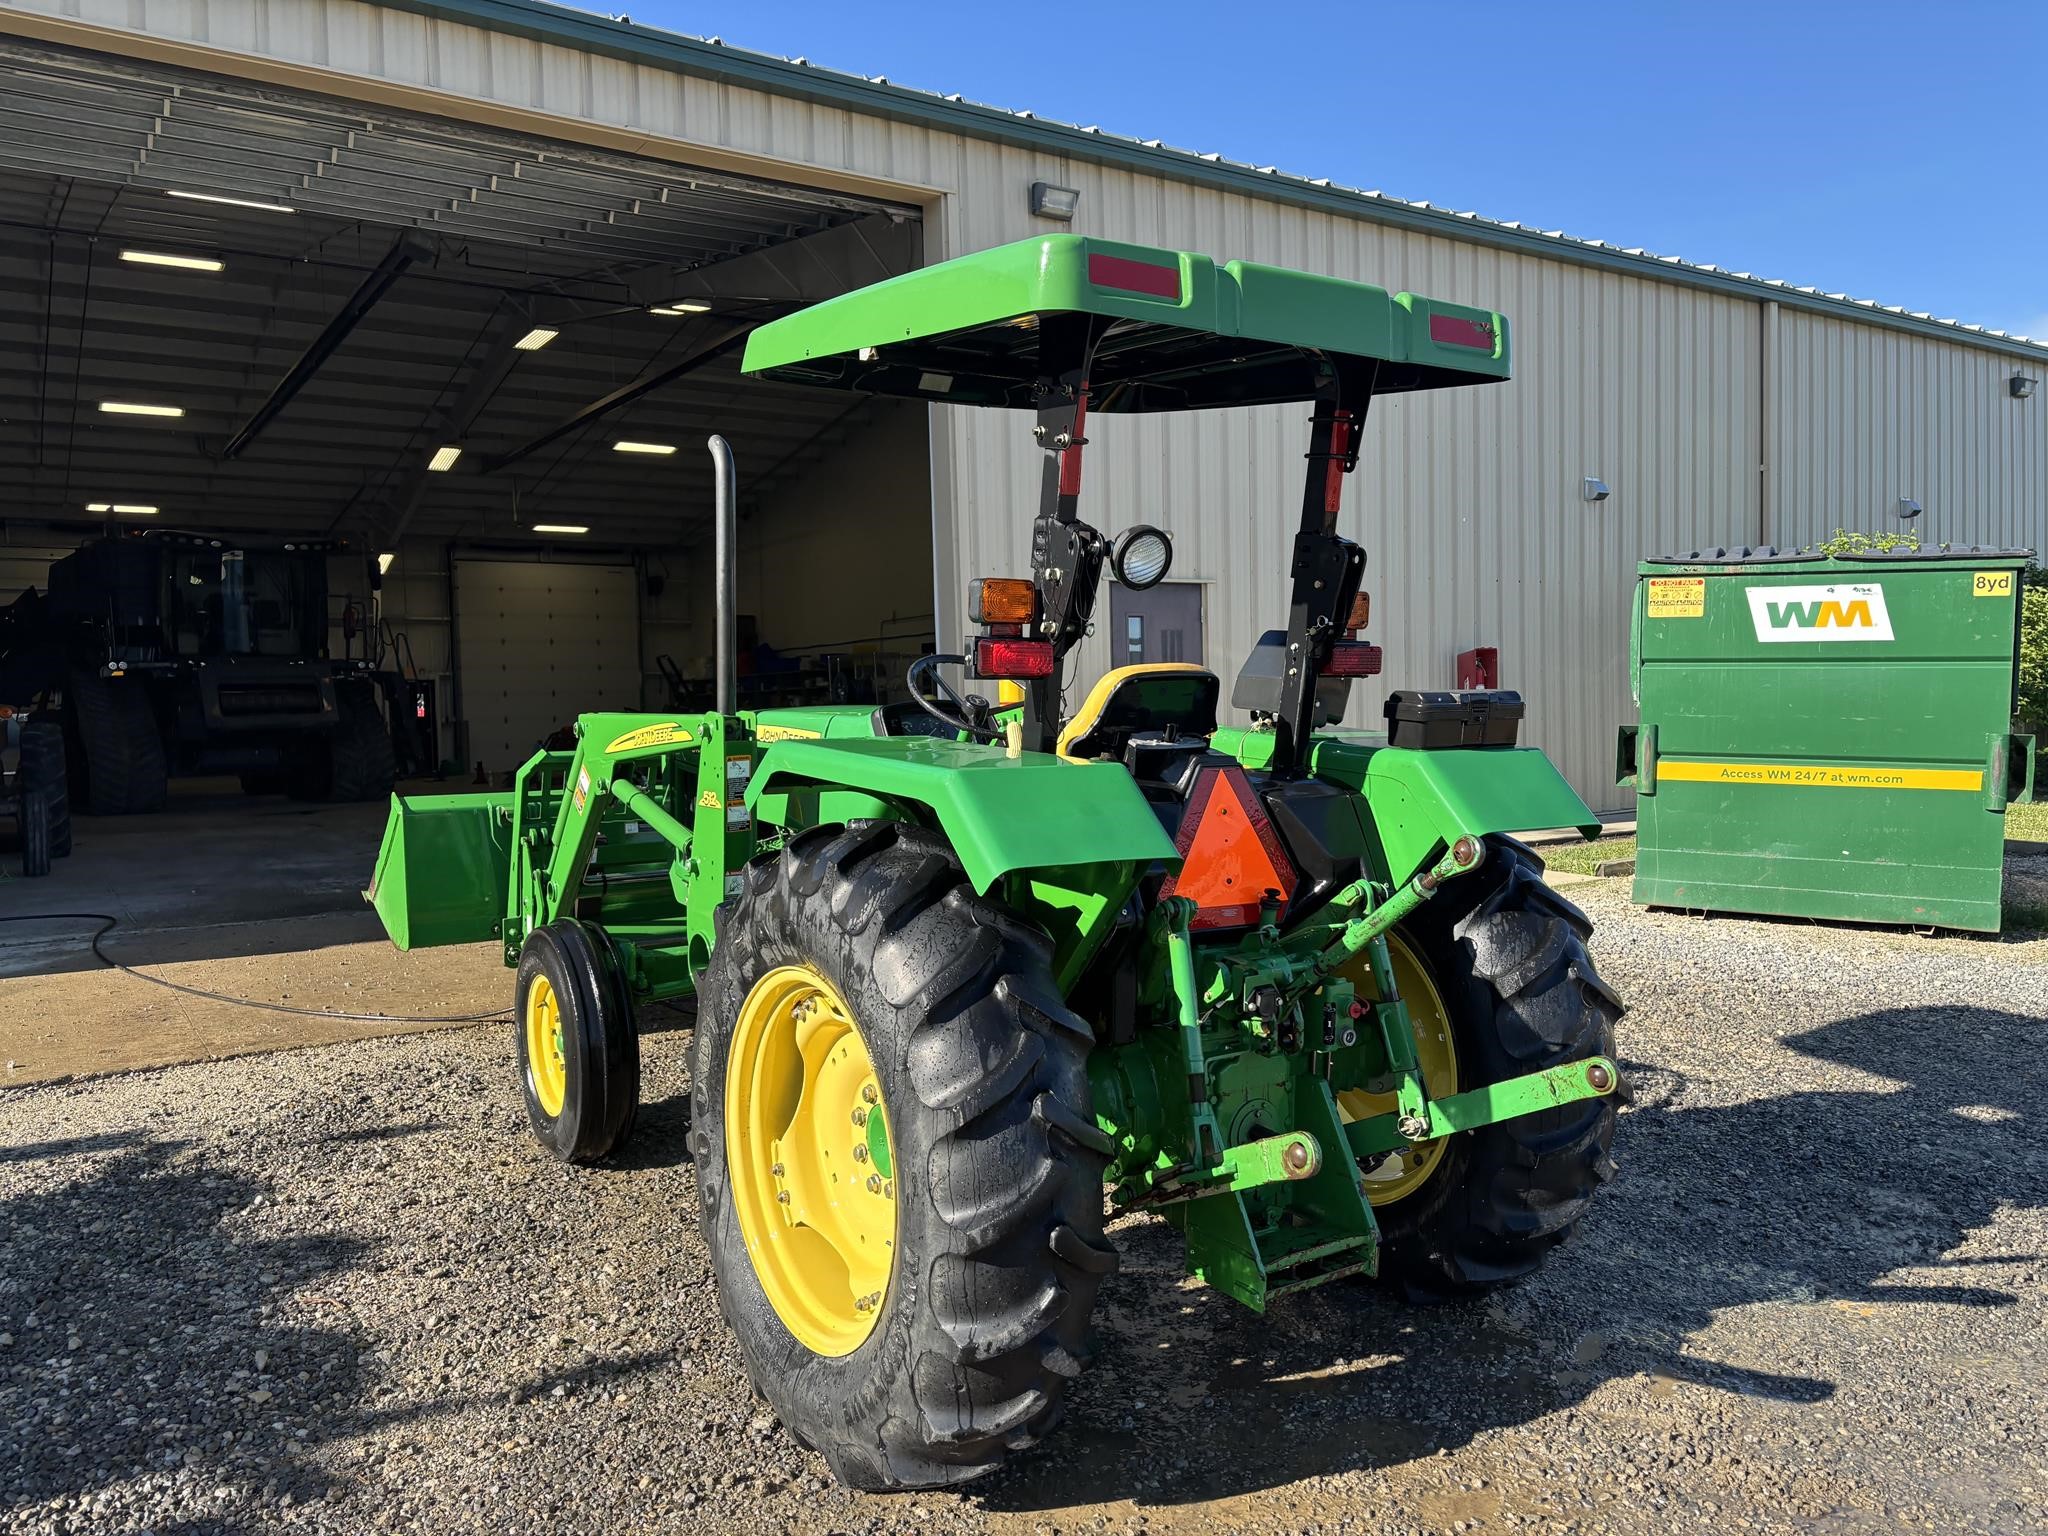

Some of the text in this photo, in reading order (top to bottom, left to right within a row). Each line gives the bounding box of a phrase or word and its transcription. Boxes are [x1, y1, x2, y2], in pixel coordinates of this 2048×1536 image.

[1976, 575, 2009, 593] 8yd
[1766, 600, 1873, 628] WM
[760, 728, 811, 742] JOHN DEE
[1720, 768, 1903, 784] Access WM 24/7 at wm.com
